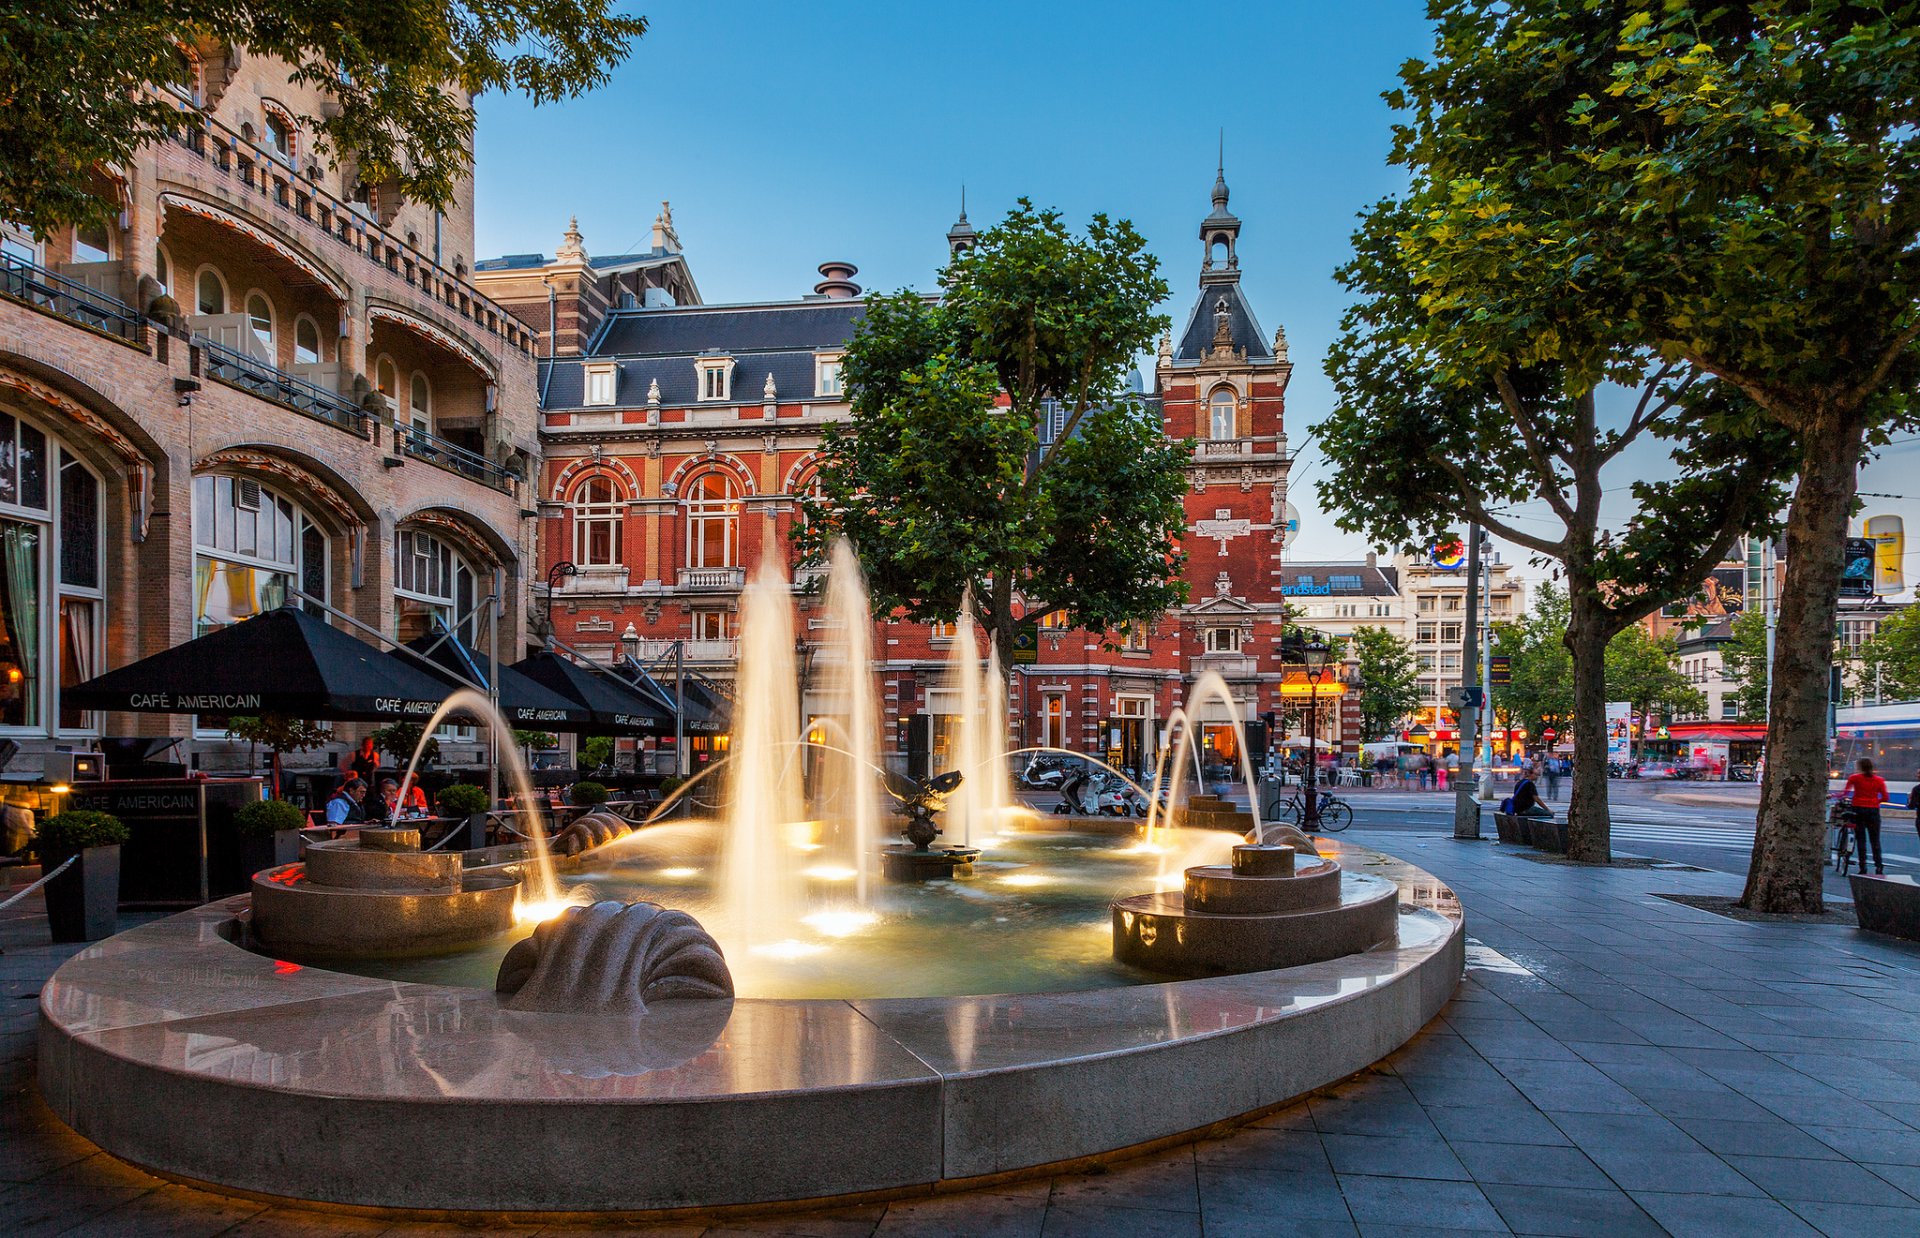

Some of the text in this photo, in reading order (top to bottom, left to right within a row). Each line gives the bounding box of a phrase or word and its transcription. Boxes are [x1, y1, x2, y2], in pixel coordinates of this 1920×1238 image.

[1281, 582, 1331, 596] andstad
[130, 692, 260, 708] CAFÉ AMERICAIN
[375, 698, 402, 713] CAFÉ
[517, 707, 567, 720] CAFÉ AMERICAIN
[615, 714, 629, 725] CAFÉ
[117, 795, 195, 809] AMERICAIN
